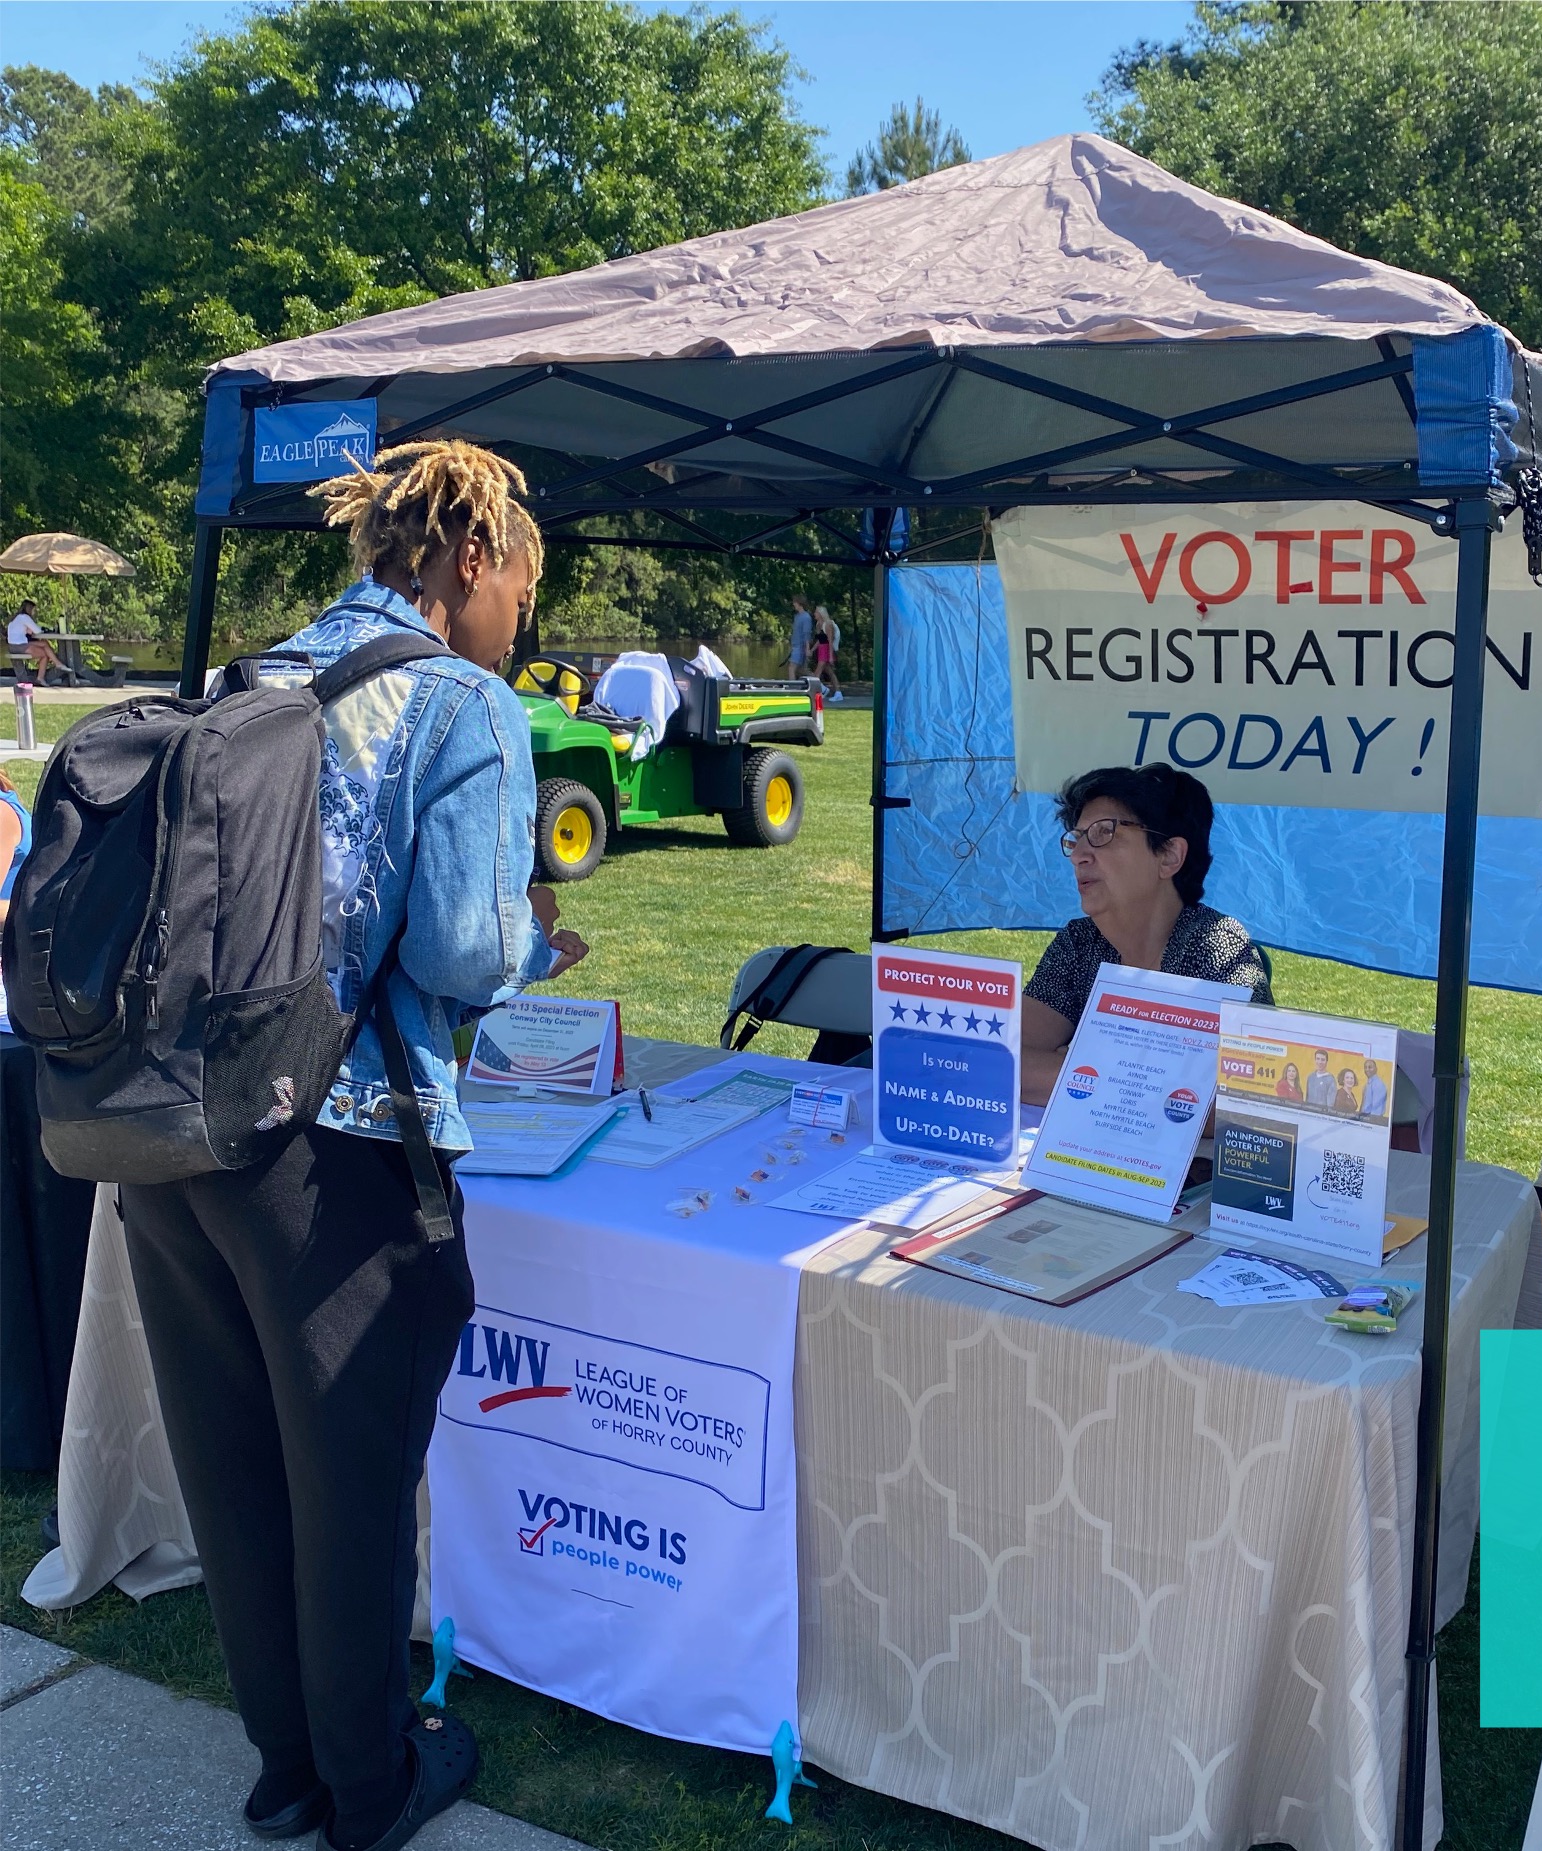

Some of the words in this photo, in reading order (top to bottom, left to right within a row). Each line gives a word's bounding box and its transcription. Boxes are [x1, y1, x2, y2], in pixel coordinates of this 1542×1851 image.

[260, 441, 313, 462] EAGLE
[318, 438, 364, 458] PEAK
[1120, 530, 1427, 605] VOTER
[1026, 628, 1532, 690] REGISTRATION
[884, 968, 935, 985] PROTECT
[938, 975, 973, 991] YOUR
[977, 981, 1009, 995] VOTE
[504, 1002, 516, 1011] ne
[520, 1002, 529, 1011] 13
[532, 1005, 562, 1015] Special
[565, 1008, 600, 1018] Election
[1110, 1003, 1138, 1016] READY
[1150, 1011, 1191, 1026] ELECTION
[1192, 1018, 1219, 1031] 2023?
[510, 1013, 537, 1023] Conway
[540, 1016, 553, 1026] City
[554, 1018, 581, 1026] Council
[1117, 1060, 1144, 1071] ATLANTIC
[1145, 1065, 1166, 1075] BEACH
[1127, 1071, 1148, 1080] AYNOR
[1223, 1060, 1253, 1074] VOTE
[1257, 1066, 1275, 1079] 411
[1067, 1081, 1095, 1092] COUNCIL
[1073, 1073, 1096, 1085] CITY
[1108, 1076, 1143, 1089] BRIARCLIFFE
[1143, 1084, 1163, 1093] ACRES
[931, 1091, 939, 1102] &
[1119, 1088, 1146, 1099] CONWAY
[1120, 1098, 1137, 1106] LORIS
[1177, 1092, 1193, 1100] YOUR
[1103, 1103, 1126, 1114] MYRTLE
[1127, 1109, 1148, 1118] BEACH
[1169, 1100, 1195, 1112] VOTE
[1090, 1109, 1110, 1120] NORTH
[1111, 1114, 1135, 1126] MYRTLE
[1135, 1120, 1156, 1130] BEACH
[1095, 1120, 1122, 1132] SURFSIDE
[1123, 1126, 1143, 1136] BEACH
[1225, 1130, 1238, 1139] AN
[1240, 1132, 1284, 1148] INFORMED
[1225, 1138, 1253, 1151] VOTER
[1262, 1146, 1269, 1154] A
[1058, 1140, 1079, 1150] Update
[1079, 1146, 1093, 1154] your
[1093, 1148, 1116, 1159] address
[1225, 1147, 1270, 1164] POWERFUL
[1045, 1152, 1077, 1166] CANDIDATE
[1077, 1160, 1097, 1171] FILING
[1097, 1165, 1116, 1176] DATES
[1123, 1172, 1150, 1184] AUG-SEP
[1150, 1178, 1166, 1188] 2023
[1224, 1157, 1253, 1170] VOTER.
[1265, 1195, 1282, 1206] LWV
[1216, 1213, 1230, 1221] Visit
[457, 1322, 550, 1388] LWV
[575, 1359, 657, 1397] LEAGUE
[664, 1386, 688, 1404] OF
[575, 1383, 660, 1423] WOMEN
[665, 1406, 744, 1448] VOTERS
[592, 1418, 608, 1430] OF
[612, 1419, 665, 1447] HORRY
[670, 1436, 732, 1466] COUNTY
[517, 1489, 650, 1551] VOTING
[660, 1528, 687, 1565] IS
[552, 1540, 619, 1569] people
[626, 1560, 682, 1592] power
